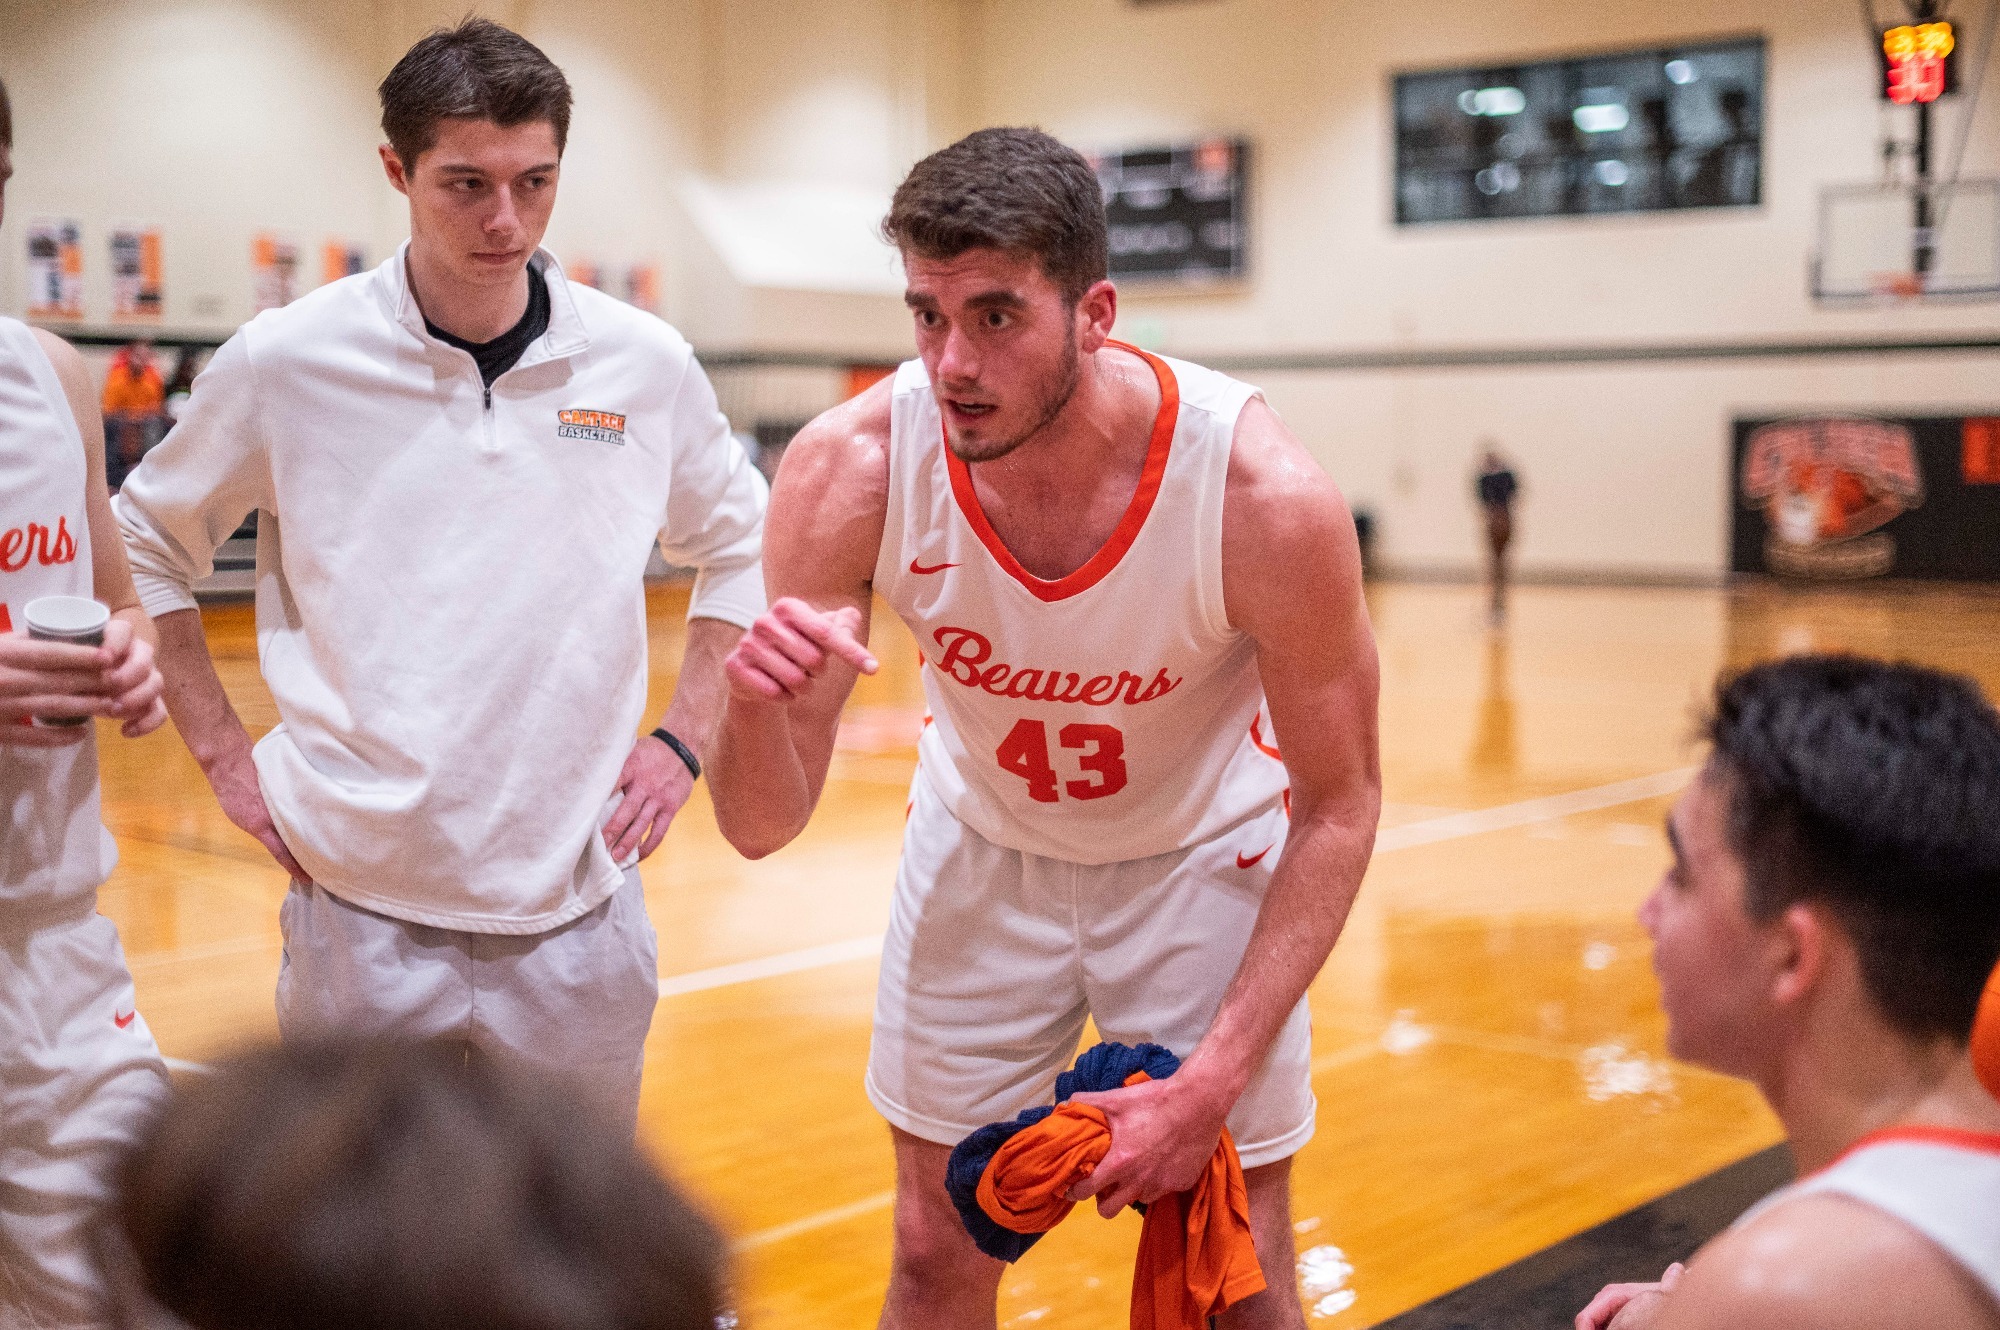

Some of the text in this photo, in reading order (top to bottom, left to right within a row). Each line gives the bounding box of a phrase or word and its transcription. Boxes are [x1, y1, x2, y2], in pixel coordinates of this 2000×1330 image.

[558, 409, 626, 433] CALTECH
[558, 426, 625, 445] BASKETBALL
[932, 626, 1183, 706] Beavers
[996, 718, 1128, 803] 43
